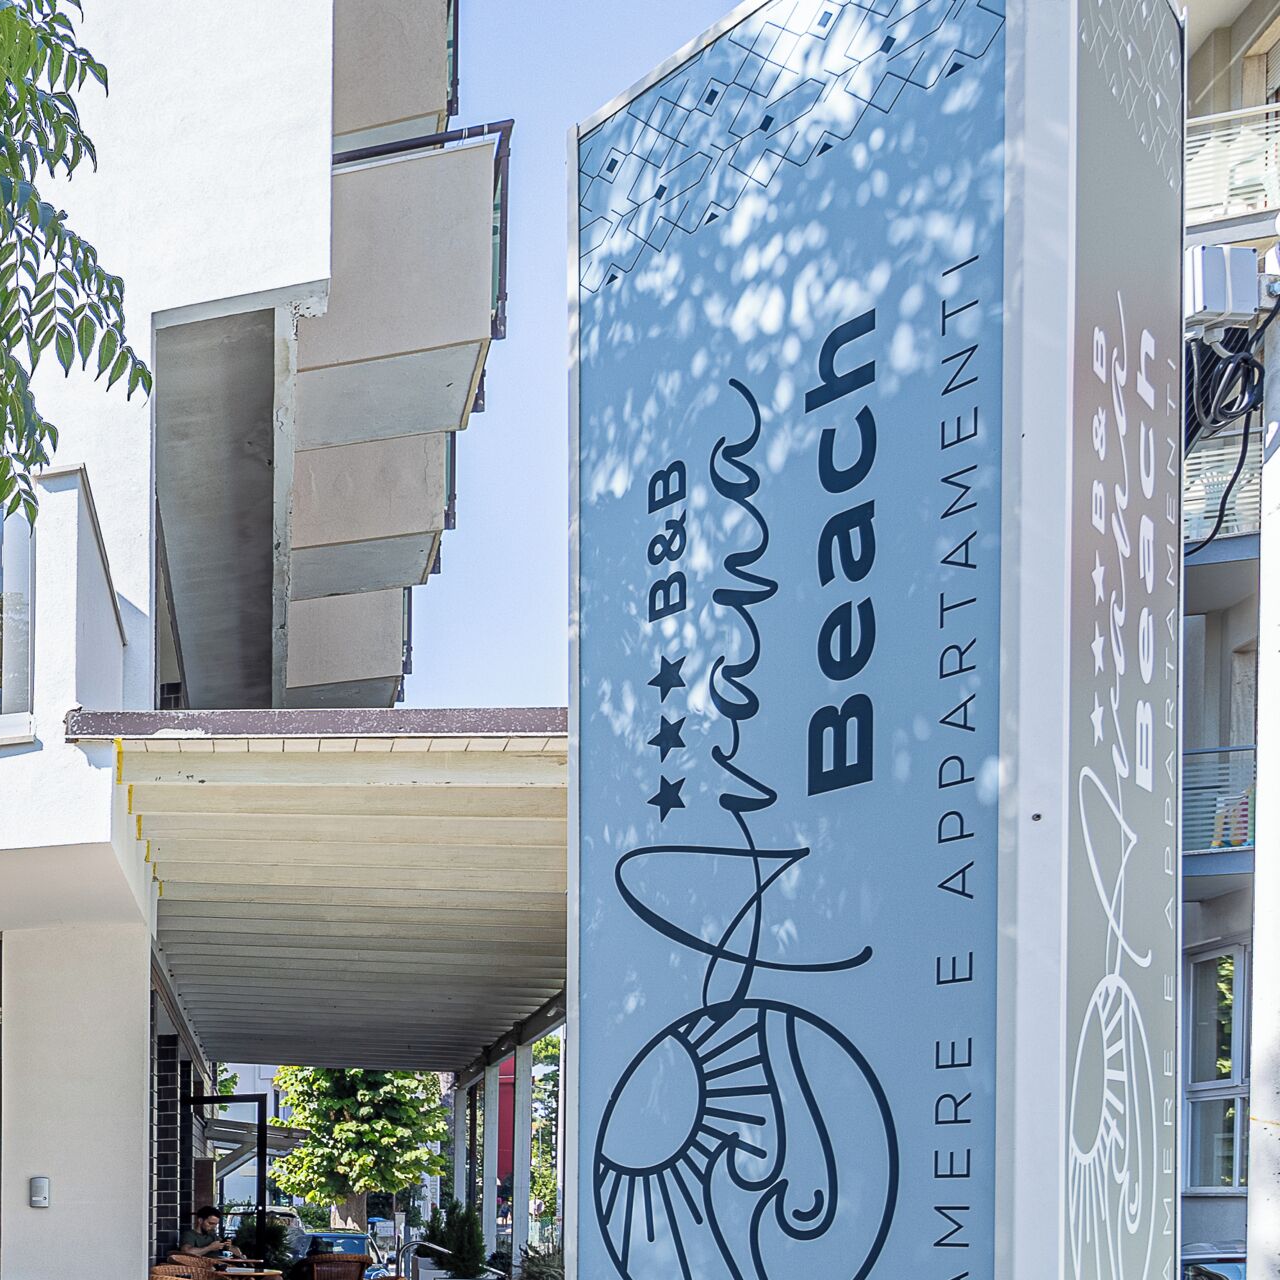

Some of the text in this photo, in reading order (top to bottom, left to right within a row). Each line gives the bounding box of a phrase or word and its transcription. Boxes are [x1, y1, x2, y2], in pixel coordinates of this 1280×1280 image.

[647, 459, 687, 623] B&B
[804, 307, 878, 797] Beach
[937, 253, 980, 899] APPARTAMENTI
[1092, 325, 1107, 535] B&B
[1136, 327, 1155, 793] Beach
[1164, 357, 1178, 930] APPARTAMENTI
[615, 377, 873, 1006] Avana
[936, 951, 974, 985] E
[1163, 973, 1174, 1001] E
